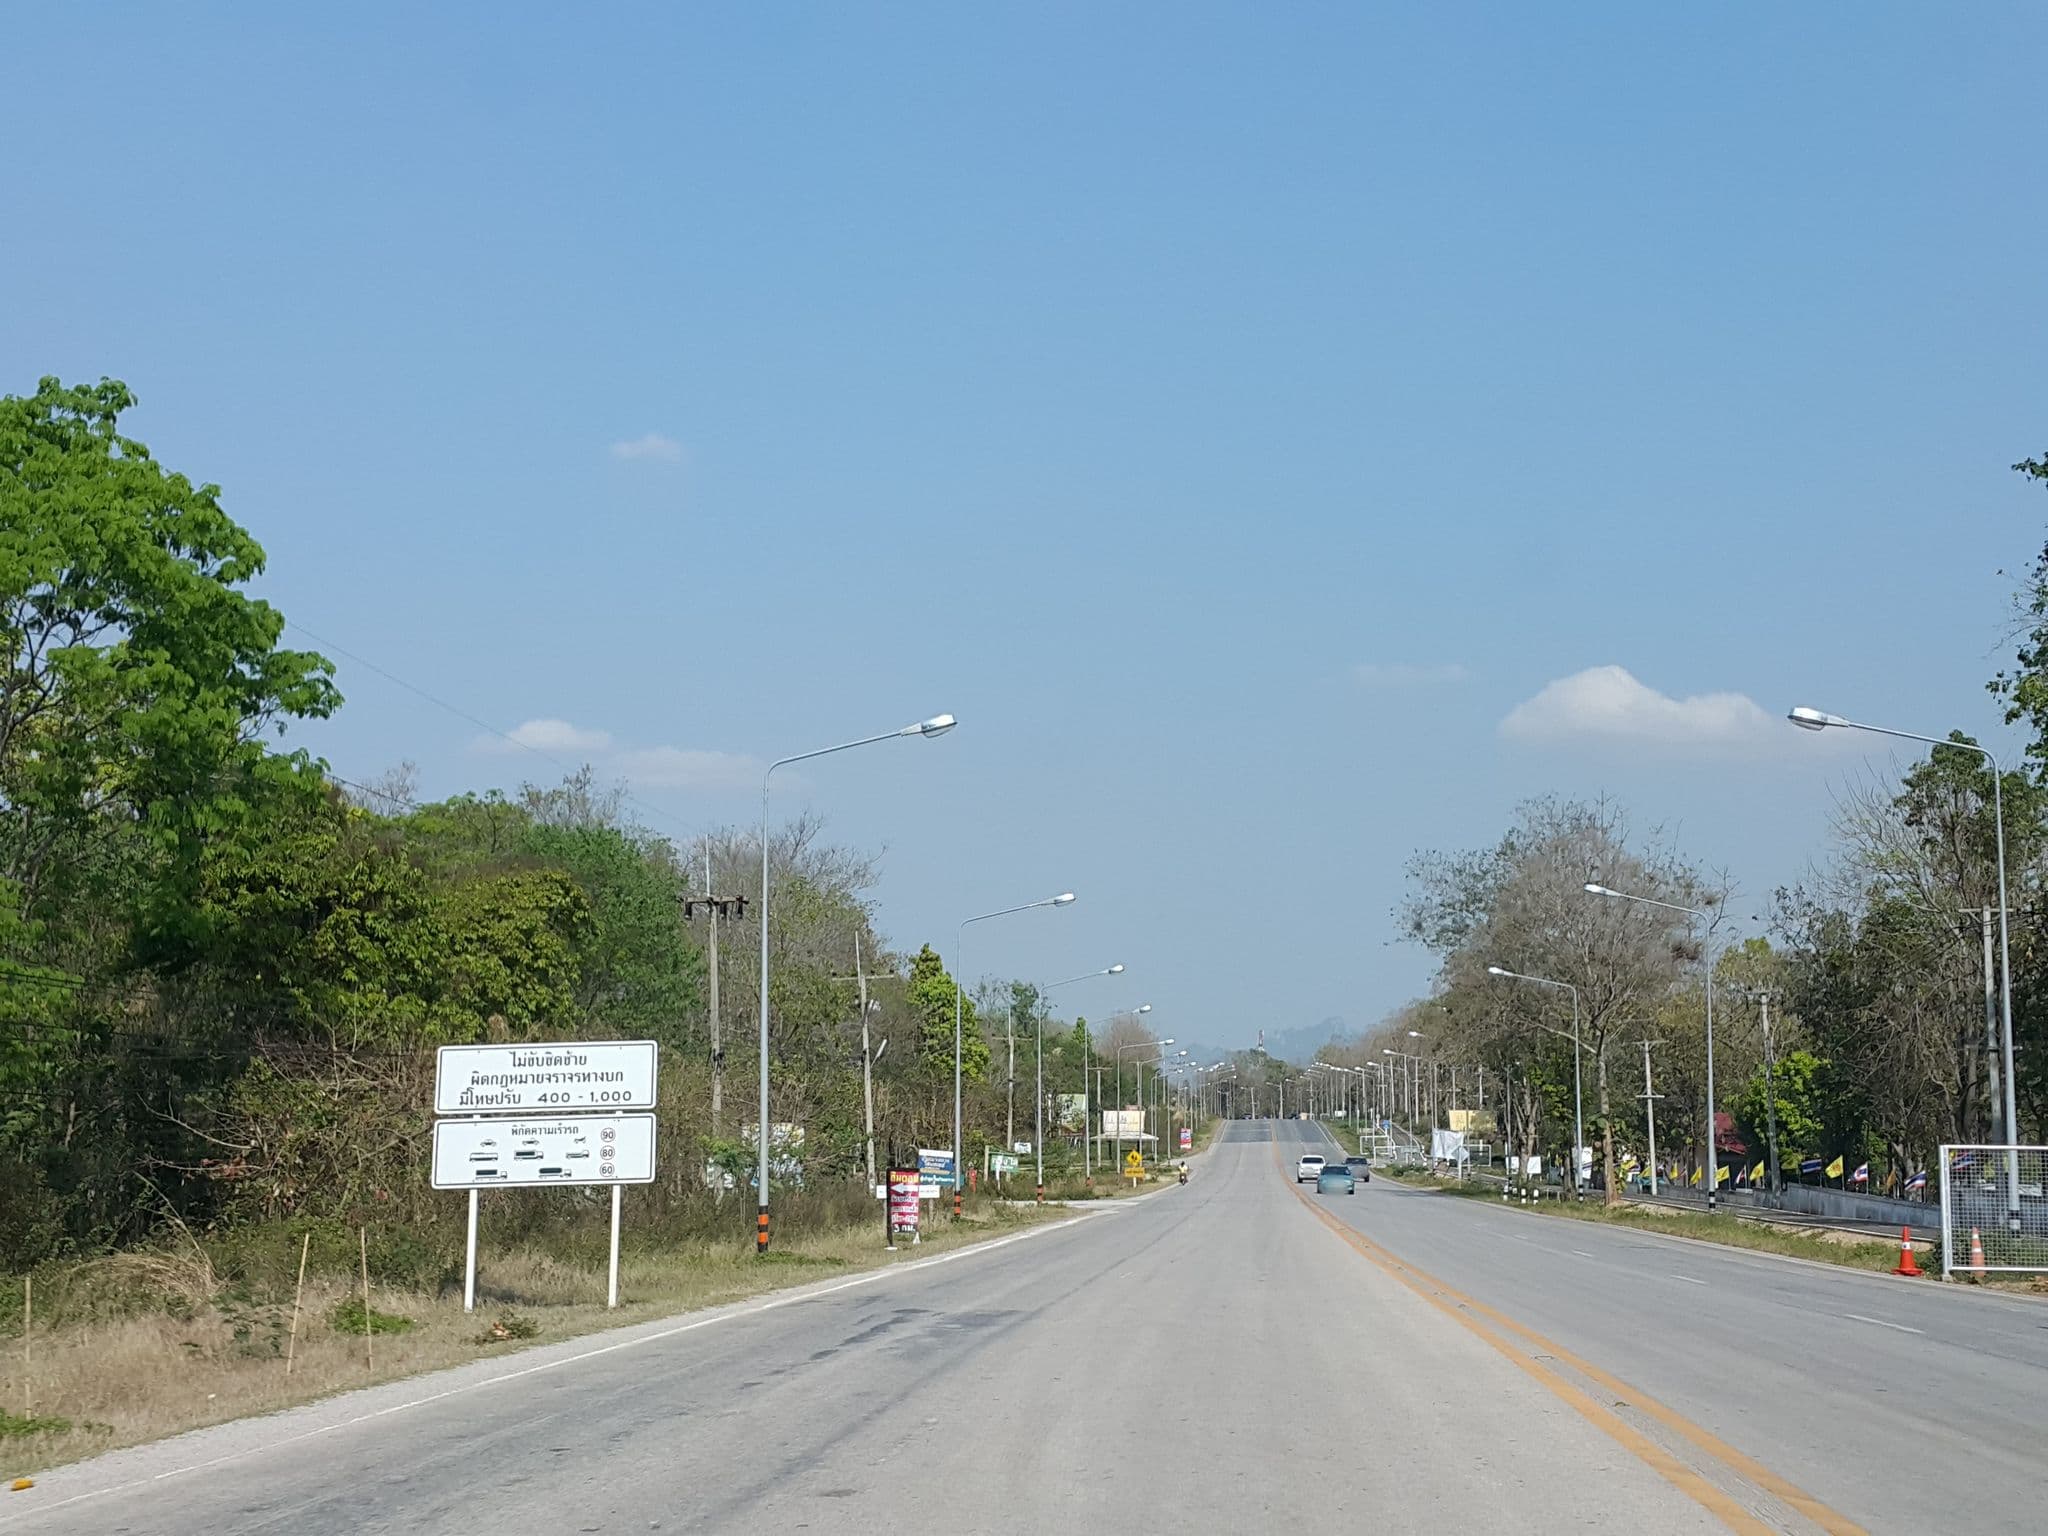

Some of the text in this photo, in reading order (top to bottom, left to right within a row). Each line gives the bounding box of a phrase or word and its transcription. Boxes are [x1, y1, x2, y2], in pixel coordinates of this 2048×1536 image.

[509, 1051, 587, 1067] ไม่ขับชิดซ้าย
[459, 1087, 521, 1106] มีโทษปรับ
[537, 1092, 571, 1103] 400
[511, 1122, 579, 1136] พิกัดความเร็วรถ
[603, 1131, 614, 1139] 90
[602, 1149, 613, 1157] 80
[602, 1166, 612, 1174] 60
